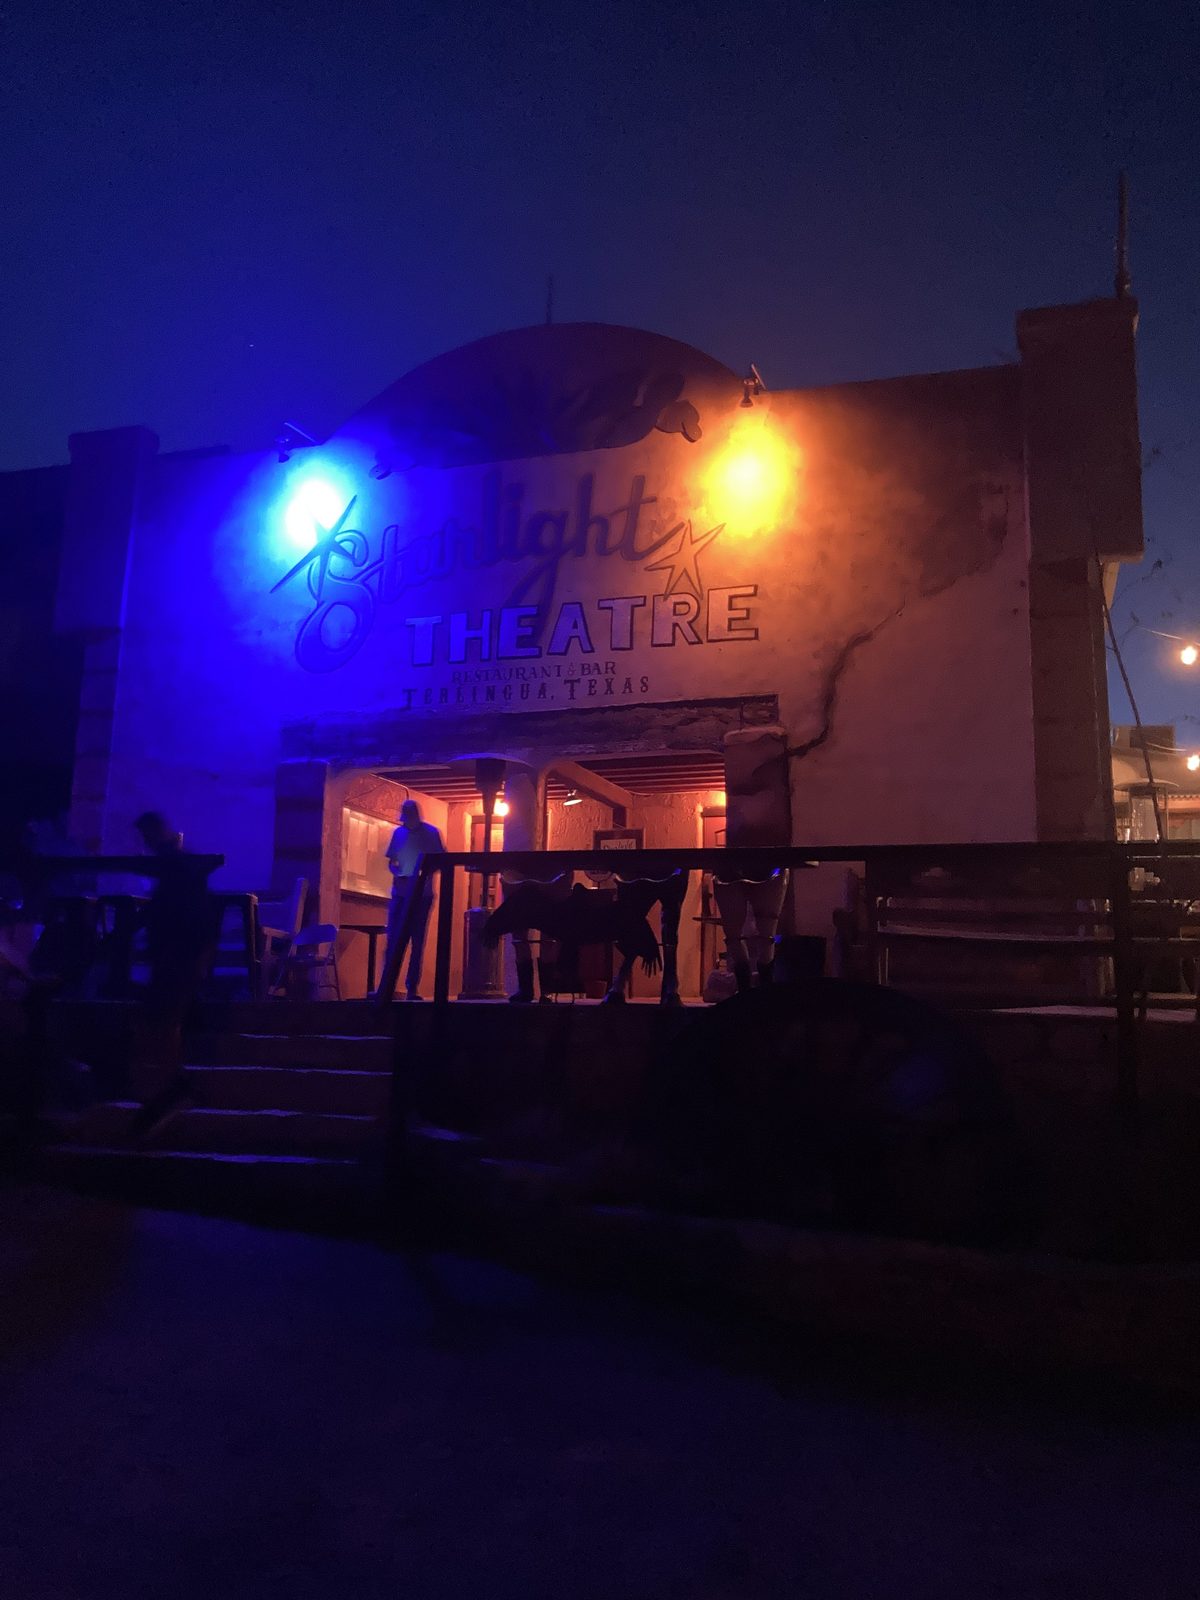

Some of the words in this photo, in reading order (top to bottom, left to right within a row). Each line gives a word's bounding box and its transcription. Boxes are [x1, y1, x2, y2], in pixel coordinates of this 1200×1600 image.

[294, 468, 686, 673] Starlight
[404, 584, 760, 669] THEATRE
[452, 664, 563, 685] RESTAURANT
[567, 662, 577, 676] &
[581, 661, 616, 676] BAR
[564, 676, 650, 701] TEXAS
